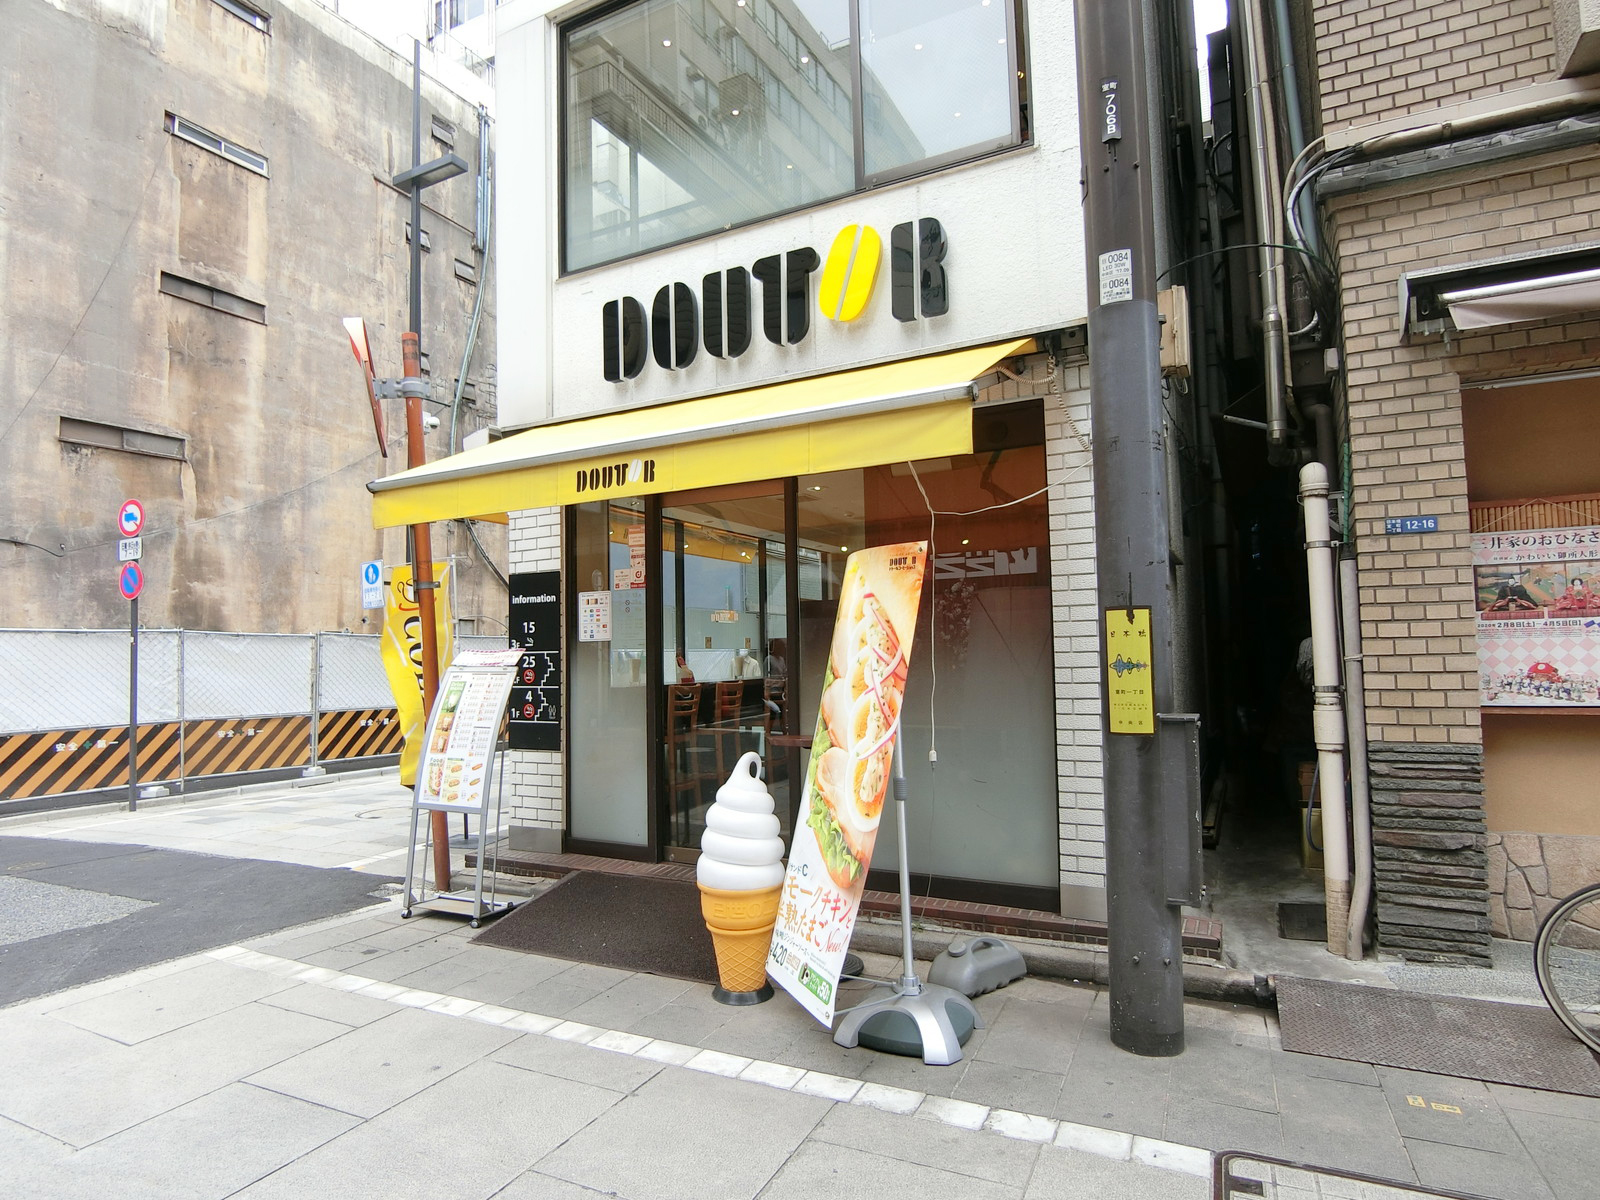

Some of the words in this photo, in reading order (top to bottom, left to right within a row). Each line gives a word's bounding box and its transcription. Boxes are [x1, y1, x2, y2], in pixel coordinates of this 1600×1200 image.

[1105, 94, 1116, 135] 706B
[1108, 252, 1128, 263] 0084
[1109, 278, 1129, 289] 0084
[602, 217, 949, 384] DOUTOR
[576, 459, 655, 492] DOUTOR
[1406, 519, 1435, 530] 12-16
[512, 594, 556, 604] information
[523, 621, 536, 634] 15
[511, 639, 521, 649] 3F
[522, 656, 536, 668] 25
[525, 691, 533, 702] 4
[511, 708, 521, 718] 1F
[217, 729, 235, 738] 安全
[55, 742, 78, 752] 安全
[97, 739, 119, 749] 第一
